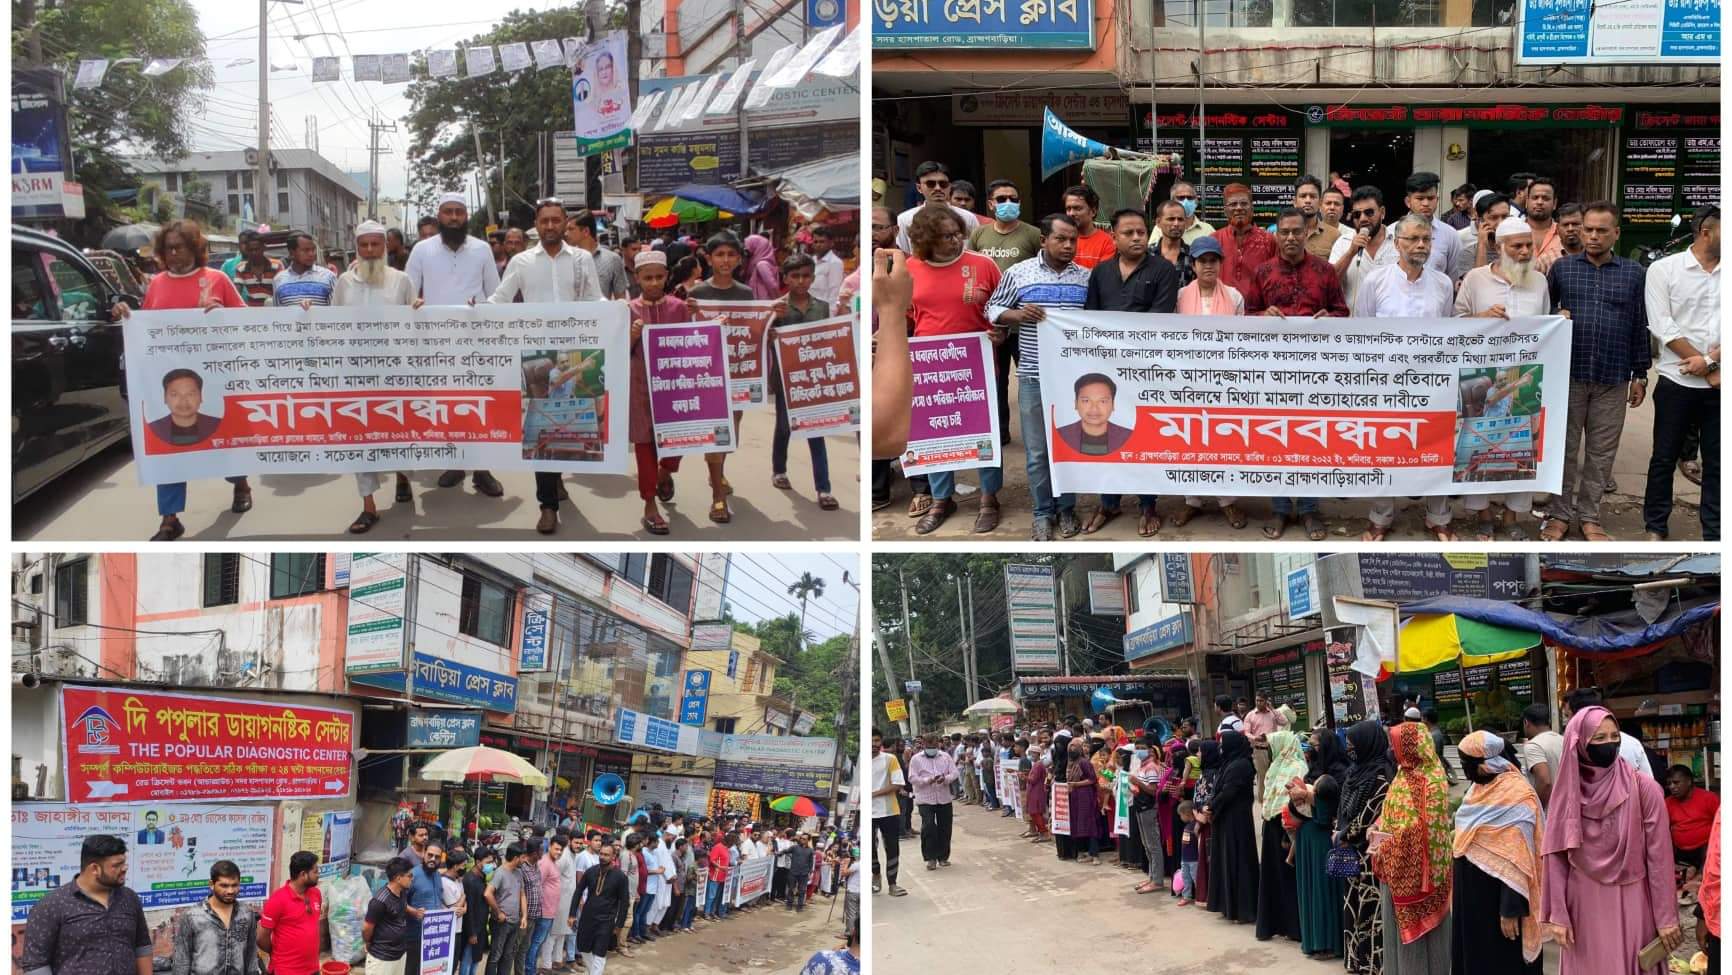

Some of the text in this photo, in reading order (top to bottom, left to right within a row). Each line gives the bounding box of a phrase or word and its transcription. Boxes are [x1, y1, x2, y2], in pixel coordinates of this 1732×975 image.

[812, 88, 859, 96] CENTER
[167, 325, 207, 337] চিকিৎসার
[211, 325, 238, 336] সংবাদ
[242, 324, 269, 335] করতে
[273, 321, 291, 334] গিয়ে
[296, 322, 312, 335] ট্রমা
[315, 322, 352, 333] জেনারেল
[357, 320, 399, 332] হাসপাতাল
[405, 321, 410, 330] ও
[471, 318, 504, 330] সেন্টারে
[508, 318, 542, 329] প্রাইভেট
[1082, 326, 1124, 339] চিকিৎসার
[1128, 330, 1157, 341] সংবাদ
[1161, 331, 1189, 342] করতে
[1192, 328, 1213, 342] গিয়ে
[1216, 330, 1234, 342] ট্রমা
[1237, 331, 1279, 342] জেনারেল
[1282, 332, 1329, 344] হাসপাতাল
[1334, 335, 1341, 344] ও
[1407, 334, 1443, 345] সেন্টারে
[1447, 334, 1484, 346] প্রাইভেট
[148, 341, 202, 356] ব্রাহ্মণবাড়িয়া
[206, 342, 246, 353] জেনারেল
[250, 339, 304, 351] হাসপাতালের
[307, 337, 345, 349] চিকিৎসক
[349, 337, 388, 348] ফয়সালের
[393, 337, 419, 347] অসভ্য
[422, 336, 451, 346] আচরণ
[455, 336, 473, 346] এবং
[523, 334, 545, 345] মিথ্যা
[549, 335, 576, 345] মামলা
[579, 334, 599, 345] দিয়ে
[1060, 346, 1537, 365] ব্রাহ্মণবাড়িয়া জেনারেল হাসপাতালের চিকিৎসক ফয়সালের অসভ্য আচরণ এবং পরবর্তীতে মিথ্যা মামলা দিয়ে
[203, 349, 512, 375] সাংবাদিক আসাদুজ্জামান আসাদকে হয়রানির প্রতিবাদে
[224, 371, 494, 392] এবং অবিলম্বে মিথ্যা মামলা প্রত্যাহারের দাবীতে
[1116, 366, 1451, 388] সাংবাদিক আসাদুজ্জামান আসাদকে হয়রানির প্রতিবাদে
[1138, 387, 1429, 408] এবং অবিলম্বে মিথ্যা মামলা প্রত্যাহারের দাবীতে
[236, 395, 496, 430] মানববন্ধন
[1148, 409, 1428, 450] মানববন্ধন
[256, 443, 457, 464] আয়োজনে সচেতন ব্রাহ্মণবাড়িয়াবাসী
[1120, 452, 1133, 461] স্থান
[1139, 451, 1179, 463] ব্রাহ্মণবাড়িয়া
[1181, 453, 1195, 462] প্রেস
[1198, 452, 1219, 462] ক্লাবের
[1221, 453, 1242, 463] সামনে,
[1245, 451, 1265, 462] তারিখ
[1272, 453, 1282, 462] ০১
[1312, 455, 1332, 464] ২০২২
[1334, 455, 1346, 466] ইং,
[1348, 454, 1373, 465] শনিবার,
[1375, 455, 1395, 464] সকাল
[1397, 455, 1419, 465] ১১.০০
[1166, 467, 1384, 488] আয়োজনে সচেতন ব্রাহ্মণবাড়িয়াবাসী
[466, 674, 490, 694] প্রেস
[493, 680, 514, 699] ক্লাব
[122, 697, 149, 735] দি
[156, 706, 220, 743] পপুলার
[316, 715, 350, 744] সেন্টার
[128, 743, 347, 761] THE POPULAR DIAGNOSTIC CENTER
[34, 807, 90, 823] জাহাঙ্গীর
[96, 811, 131, 823] আলম
